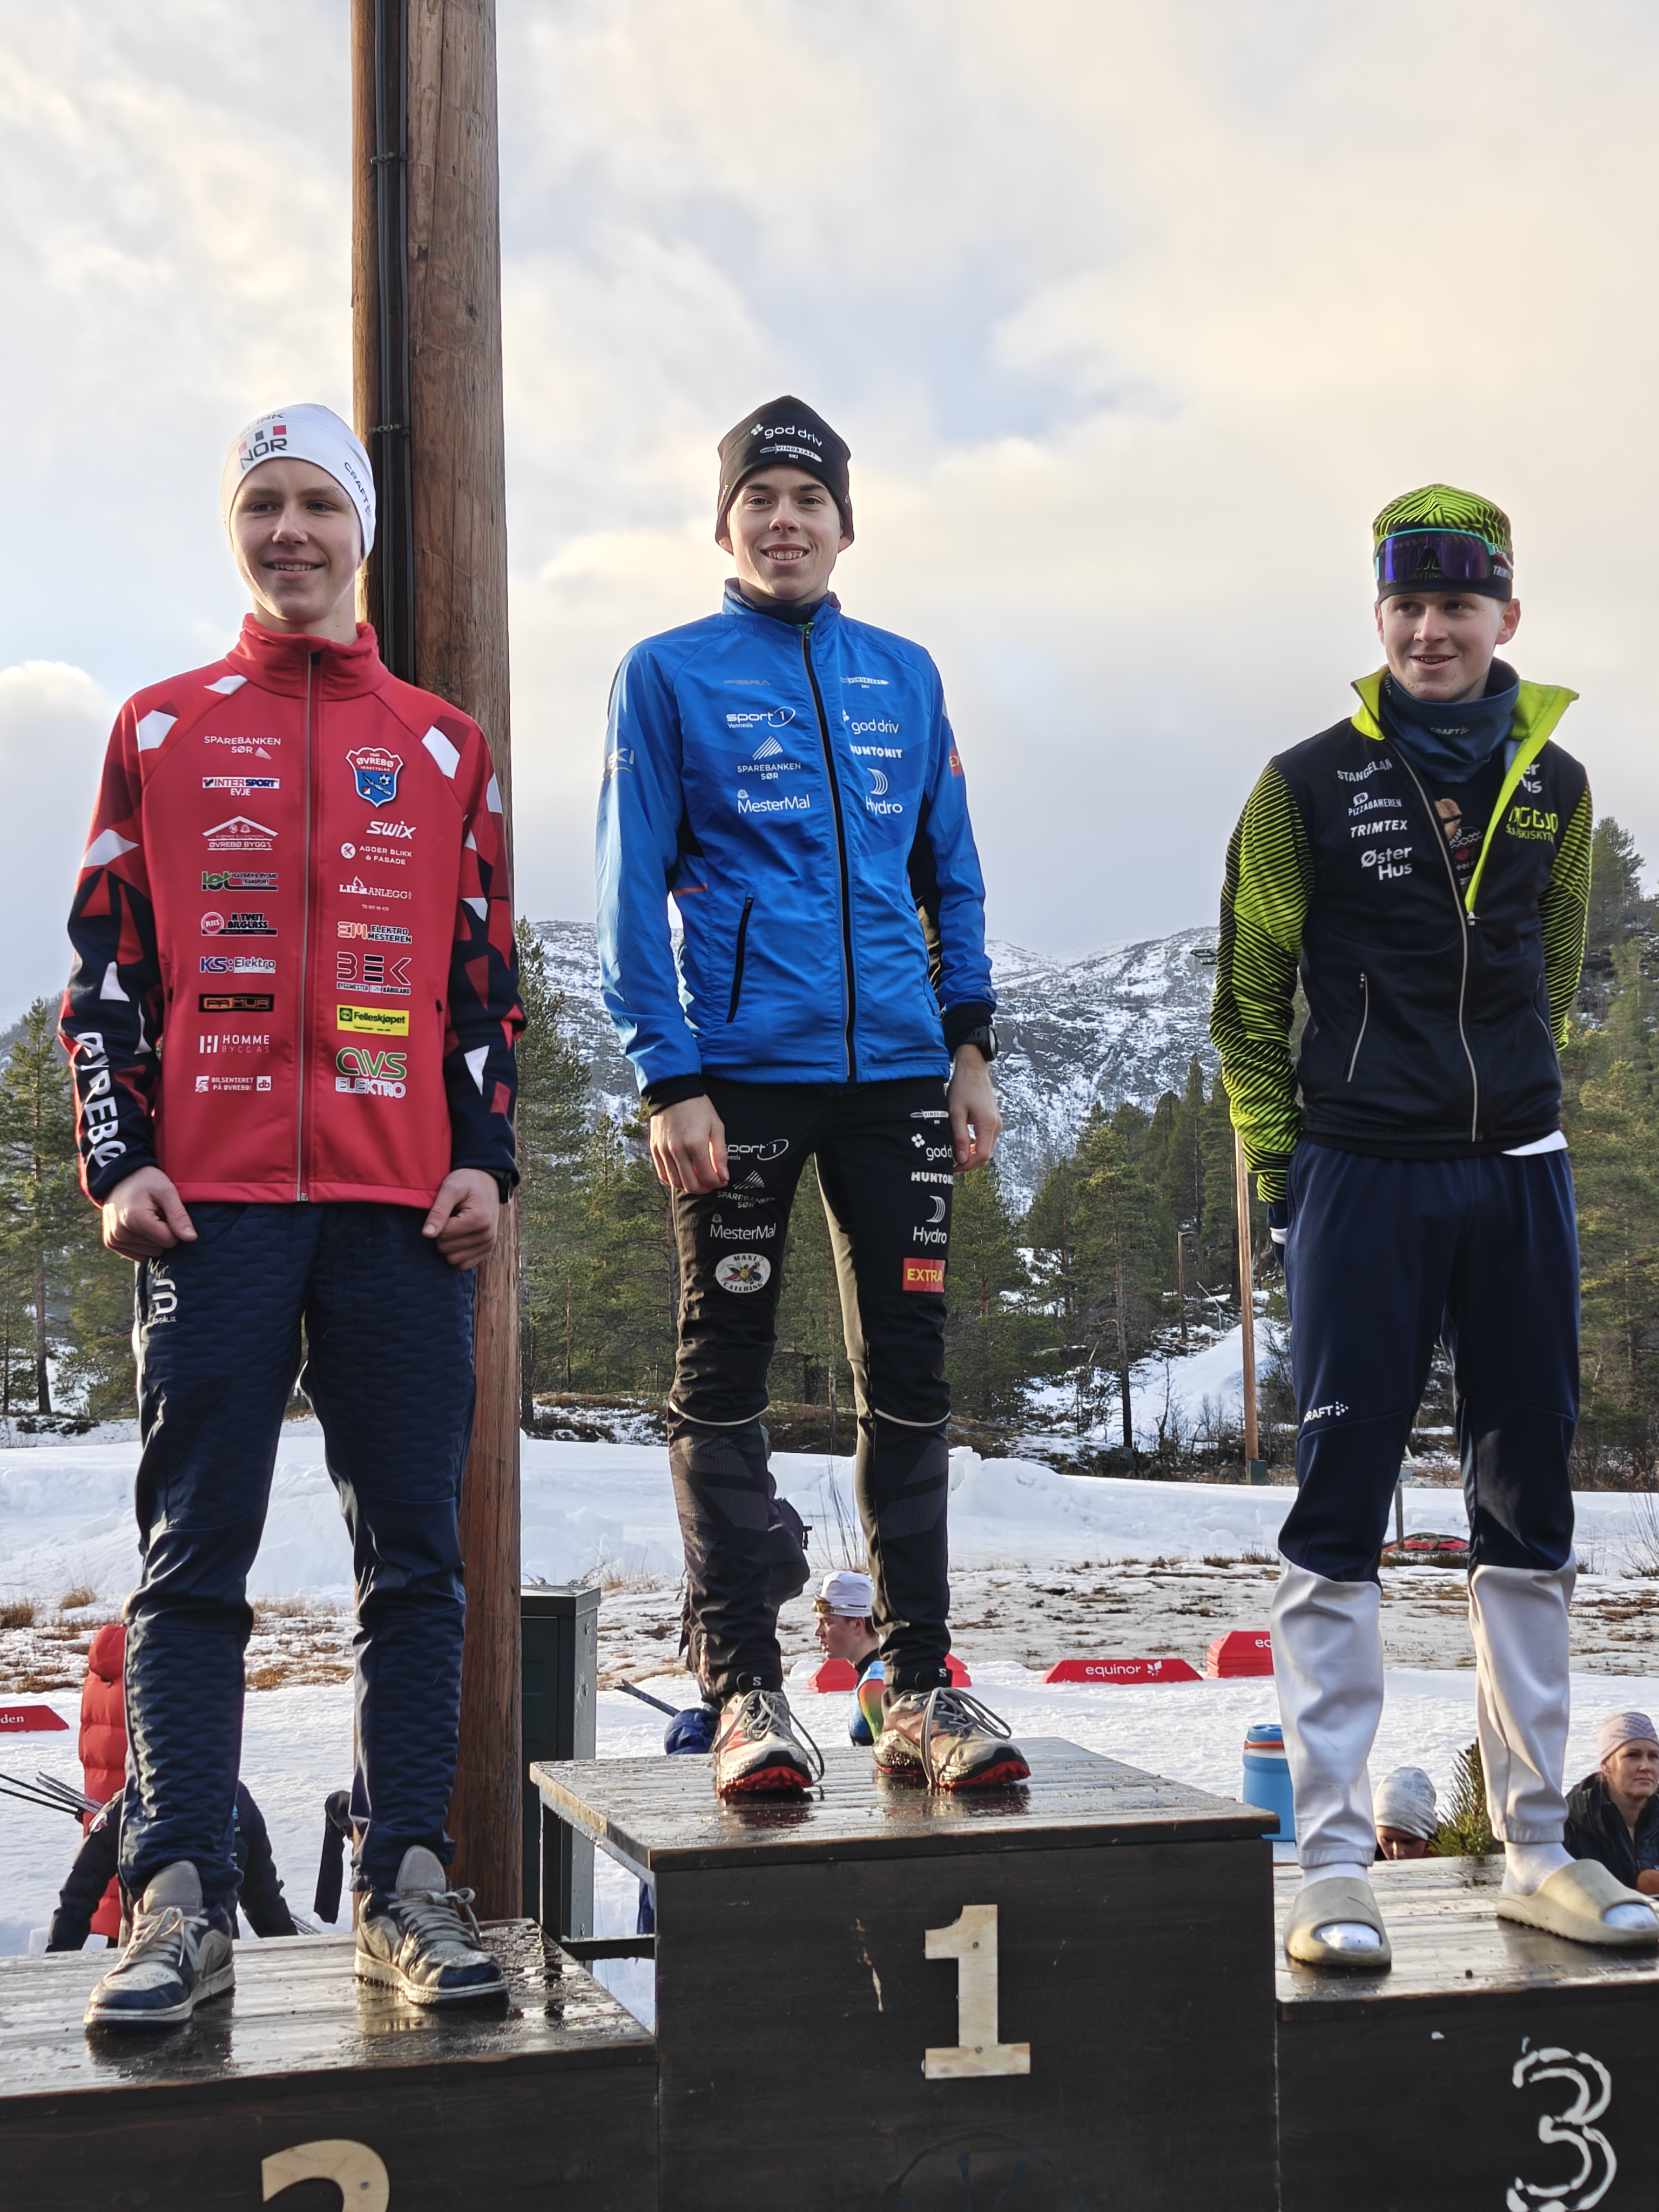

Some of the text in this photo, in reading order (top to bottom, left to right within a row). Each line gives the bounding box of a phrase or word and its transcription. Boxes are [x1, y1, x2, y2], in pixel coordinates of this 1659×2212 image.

[764, 426, 822, 447] god driv
[240, 438, 287, 470] NOR
[345, 462, 368, 503] CRAFT
[726, 711, 785, 723] sport 1
[851, 719, 899, 734] god driv
[204, 736, 281, 745] SPAREBANKEN
[231, 746, 253, 754] SØR
[356, 757, 394, 767] ØVREBØ
[737, 763, 801, 773] SPAREBANKEN
[1337, 758, 1393, 782] STANGELAN
[214, 778, 275, 787] INTERSPORT
[231, 788, 251, 796] EVJE
[738, 794, 810, 814] MesterMal
[866, 796, 903, 816] Hydro
[1348, 799, 1402, 817] PIZZABAKEREN
[1350, 820, 1408, 838] TRIMTEX
[359, 846, 412, 857] AGDER BLIKK
[1361, 847, 1412, 868] Øster
[374, 856, 406, 865] FASADE
[1378, 864, 1412, 881] Hus
[339, 885, 358, 894] LIE
[368, 887, 408, 899] ANLEGG
[371, 925, 408, 935] ELEKTRO
[368, 932, 412, 943] MESTEREN
[337, 952, 412, 985] BEK
[354, 1011, 405, 1024] Felleskjøpet
[222, 1035, 270, 1044] HOMME
[335, 1077, 406, 1098] ELEKTRO
[726, 1144, 765, 1154] port
[926, 1144, 947, 1161] god
[911, 1171, 953, 1184] HUNTON
[717, 1191, 776, 1204] SPAREBANKEN
[710, 1222, 776, 1240] MesterMal
[913, 1226, 947, 1245] Hydro
[907, 1268, 943, 1282] EXTRA
[724, 1282, 763, 1291] CATERING
[1255, 1637, 1272, 1649] eq
[1085, 1663, 1141, 1677] equinor
[0, 1714, 24, 1724] den
[925, 1904, 1030, 2079] 1
[1507, 2044, 1617, 2212] 3
